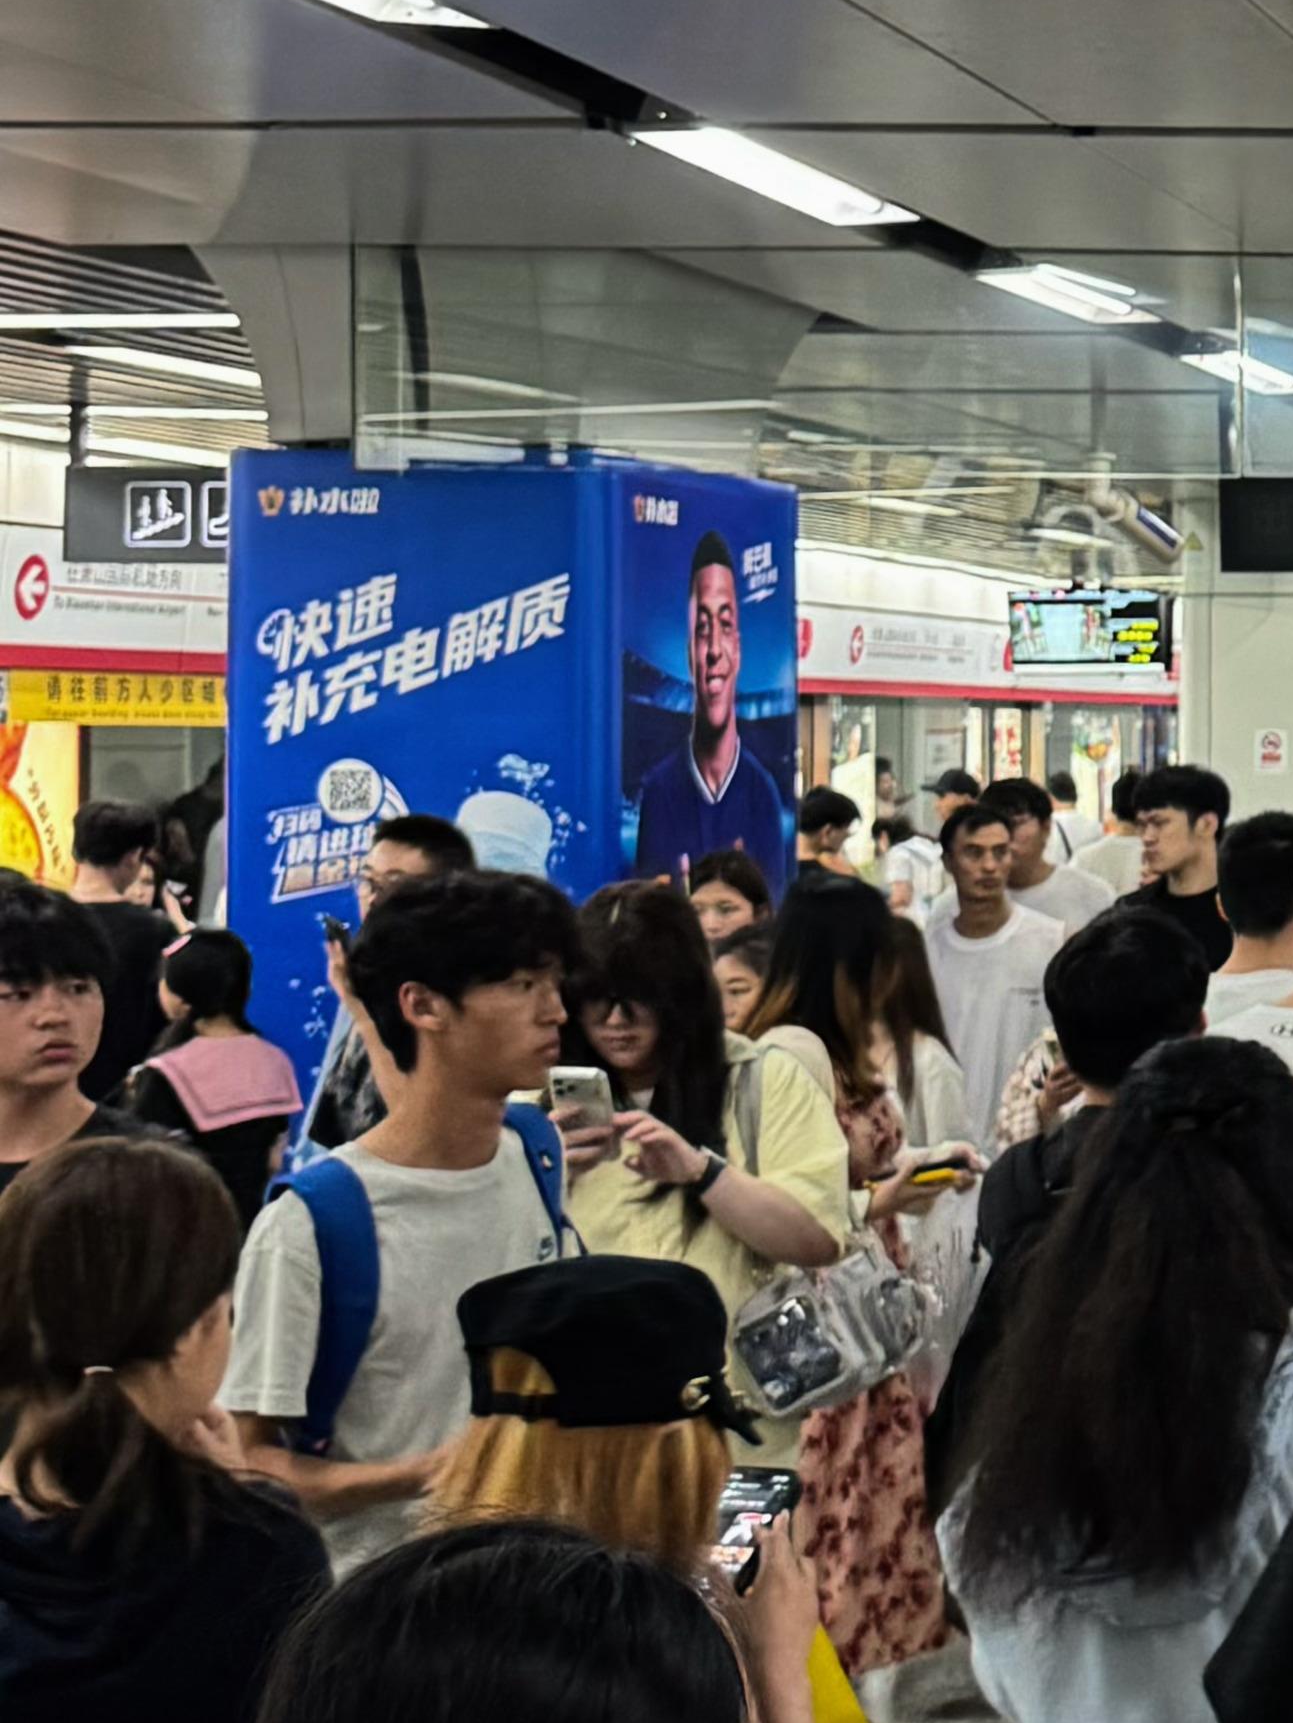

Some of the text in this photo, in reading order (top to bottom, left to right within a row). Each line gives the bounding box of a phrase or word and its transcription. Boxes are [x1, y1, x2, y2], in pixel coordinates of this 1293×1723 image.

[290, 487, 380, 515] 补水啦
[257, 573, 397, 674] 快速
[264, 573, 571, 746] 补充电解质
